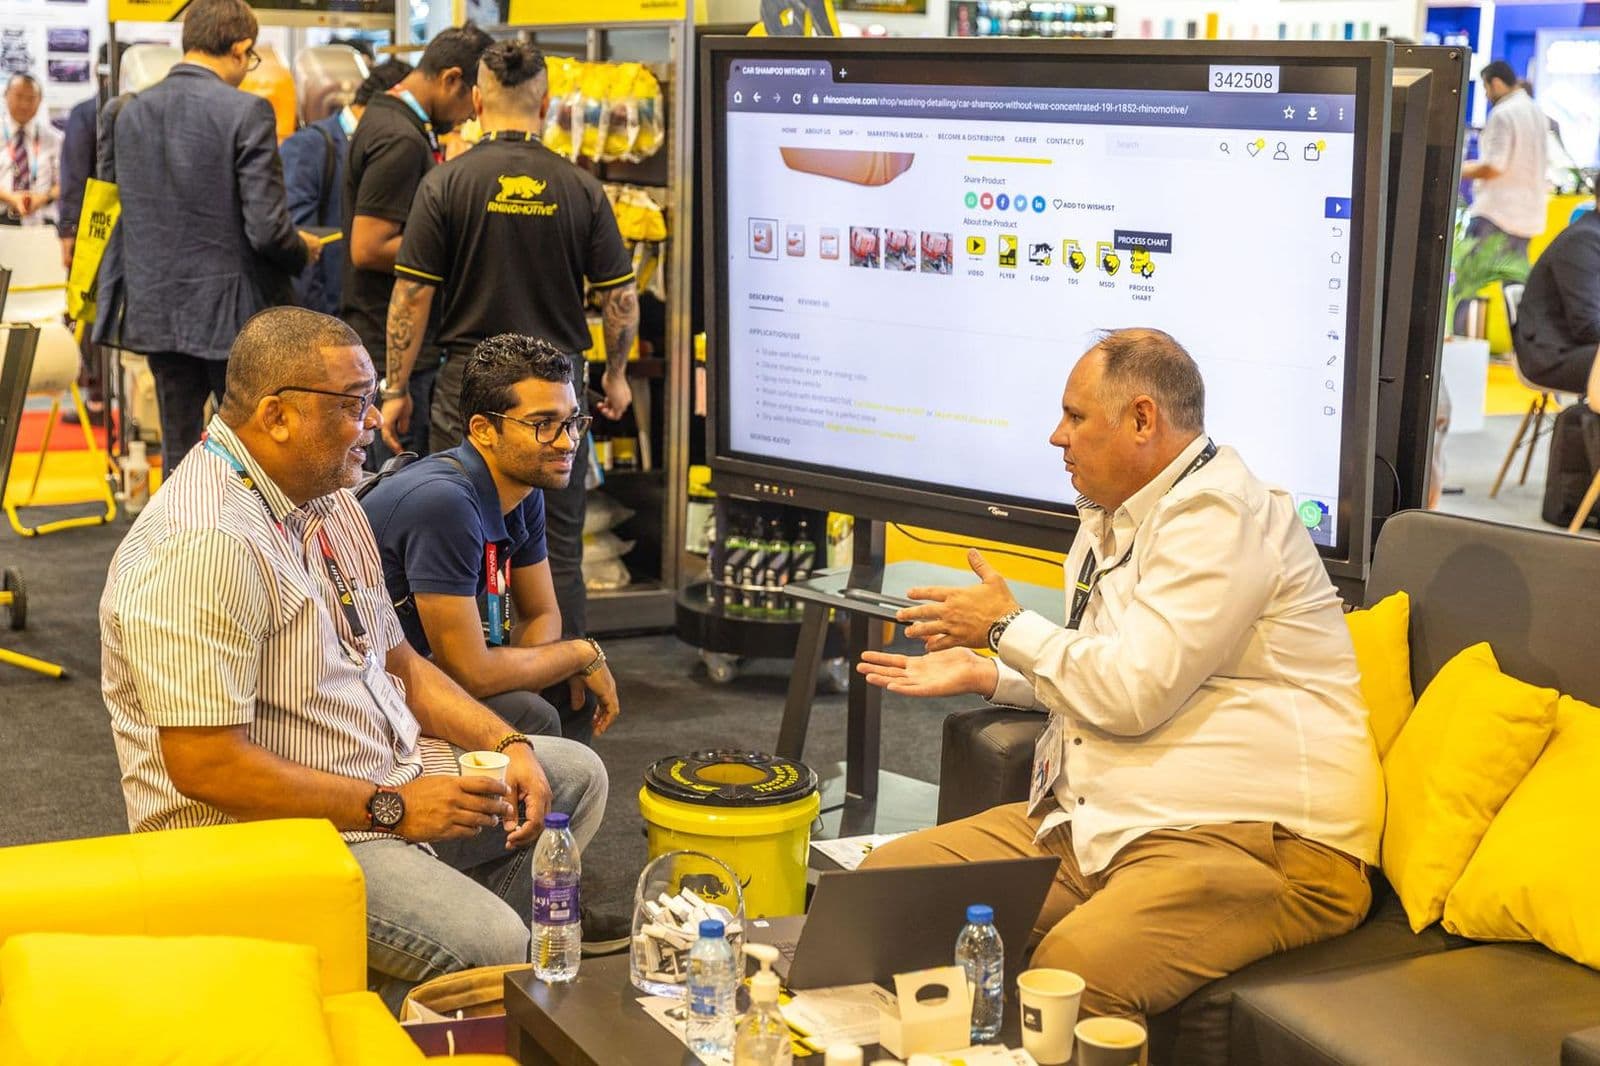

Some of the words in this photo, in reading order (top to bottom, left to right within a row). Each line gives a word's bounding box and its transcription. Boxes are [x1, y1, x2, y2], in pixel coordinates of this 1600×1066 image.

[742, 66, 755, 75] CAR
[755, 66, 783, 75] SHAMPOO
[784, 67, 811, 76] WITHOUT
[1214, 71, 1274, 89] 342508
[866, 130, 899, 138] MARKETING
[905, 131, 923, 139] MEDIA
[938, 133, 962, 141] BECOME
[967, 134, 1005, 143] DISTRIBUTOR
[1014, 136, 1038, 144] CAREER
[1046, 137, 1075, 146] CONTACT
[1076, 138, 1085, 146] US
[963, 175, 981, 185] Share
[982, 176, 1006, 186] Product
[487, 201, 555, 216] RHINOMOTIVE
[1087, 204, 1115, 212] WISHLIST
[963, 217, 981, 226] About
[982, 218, 992, 227] the
[993, 218, 1017, 229] Product
[88, 225, 105, 240] THE
[1117, 236, 1147, 246] PROCESS
[1147, 237, 1169, 247] CHART
[999, 272, 1016, 280] FLYER
[1099, 281, 1116, 289] MSDS
[1129, 284, 1155, 293] PROCESS
[749, 293, 784, 303] DESCRIPTION
[1132, 293, 1152, 301] CHART
